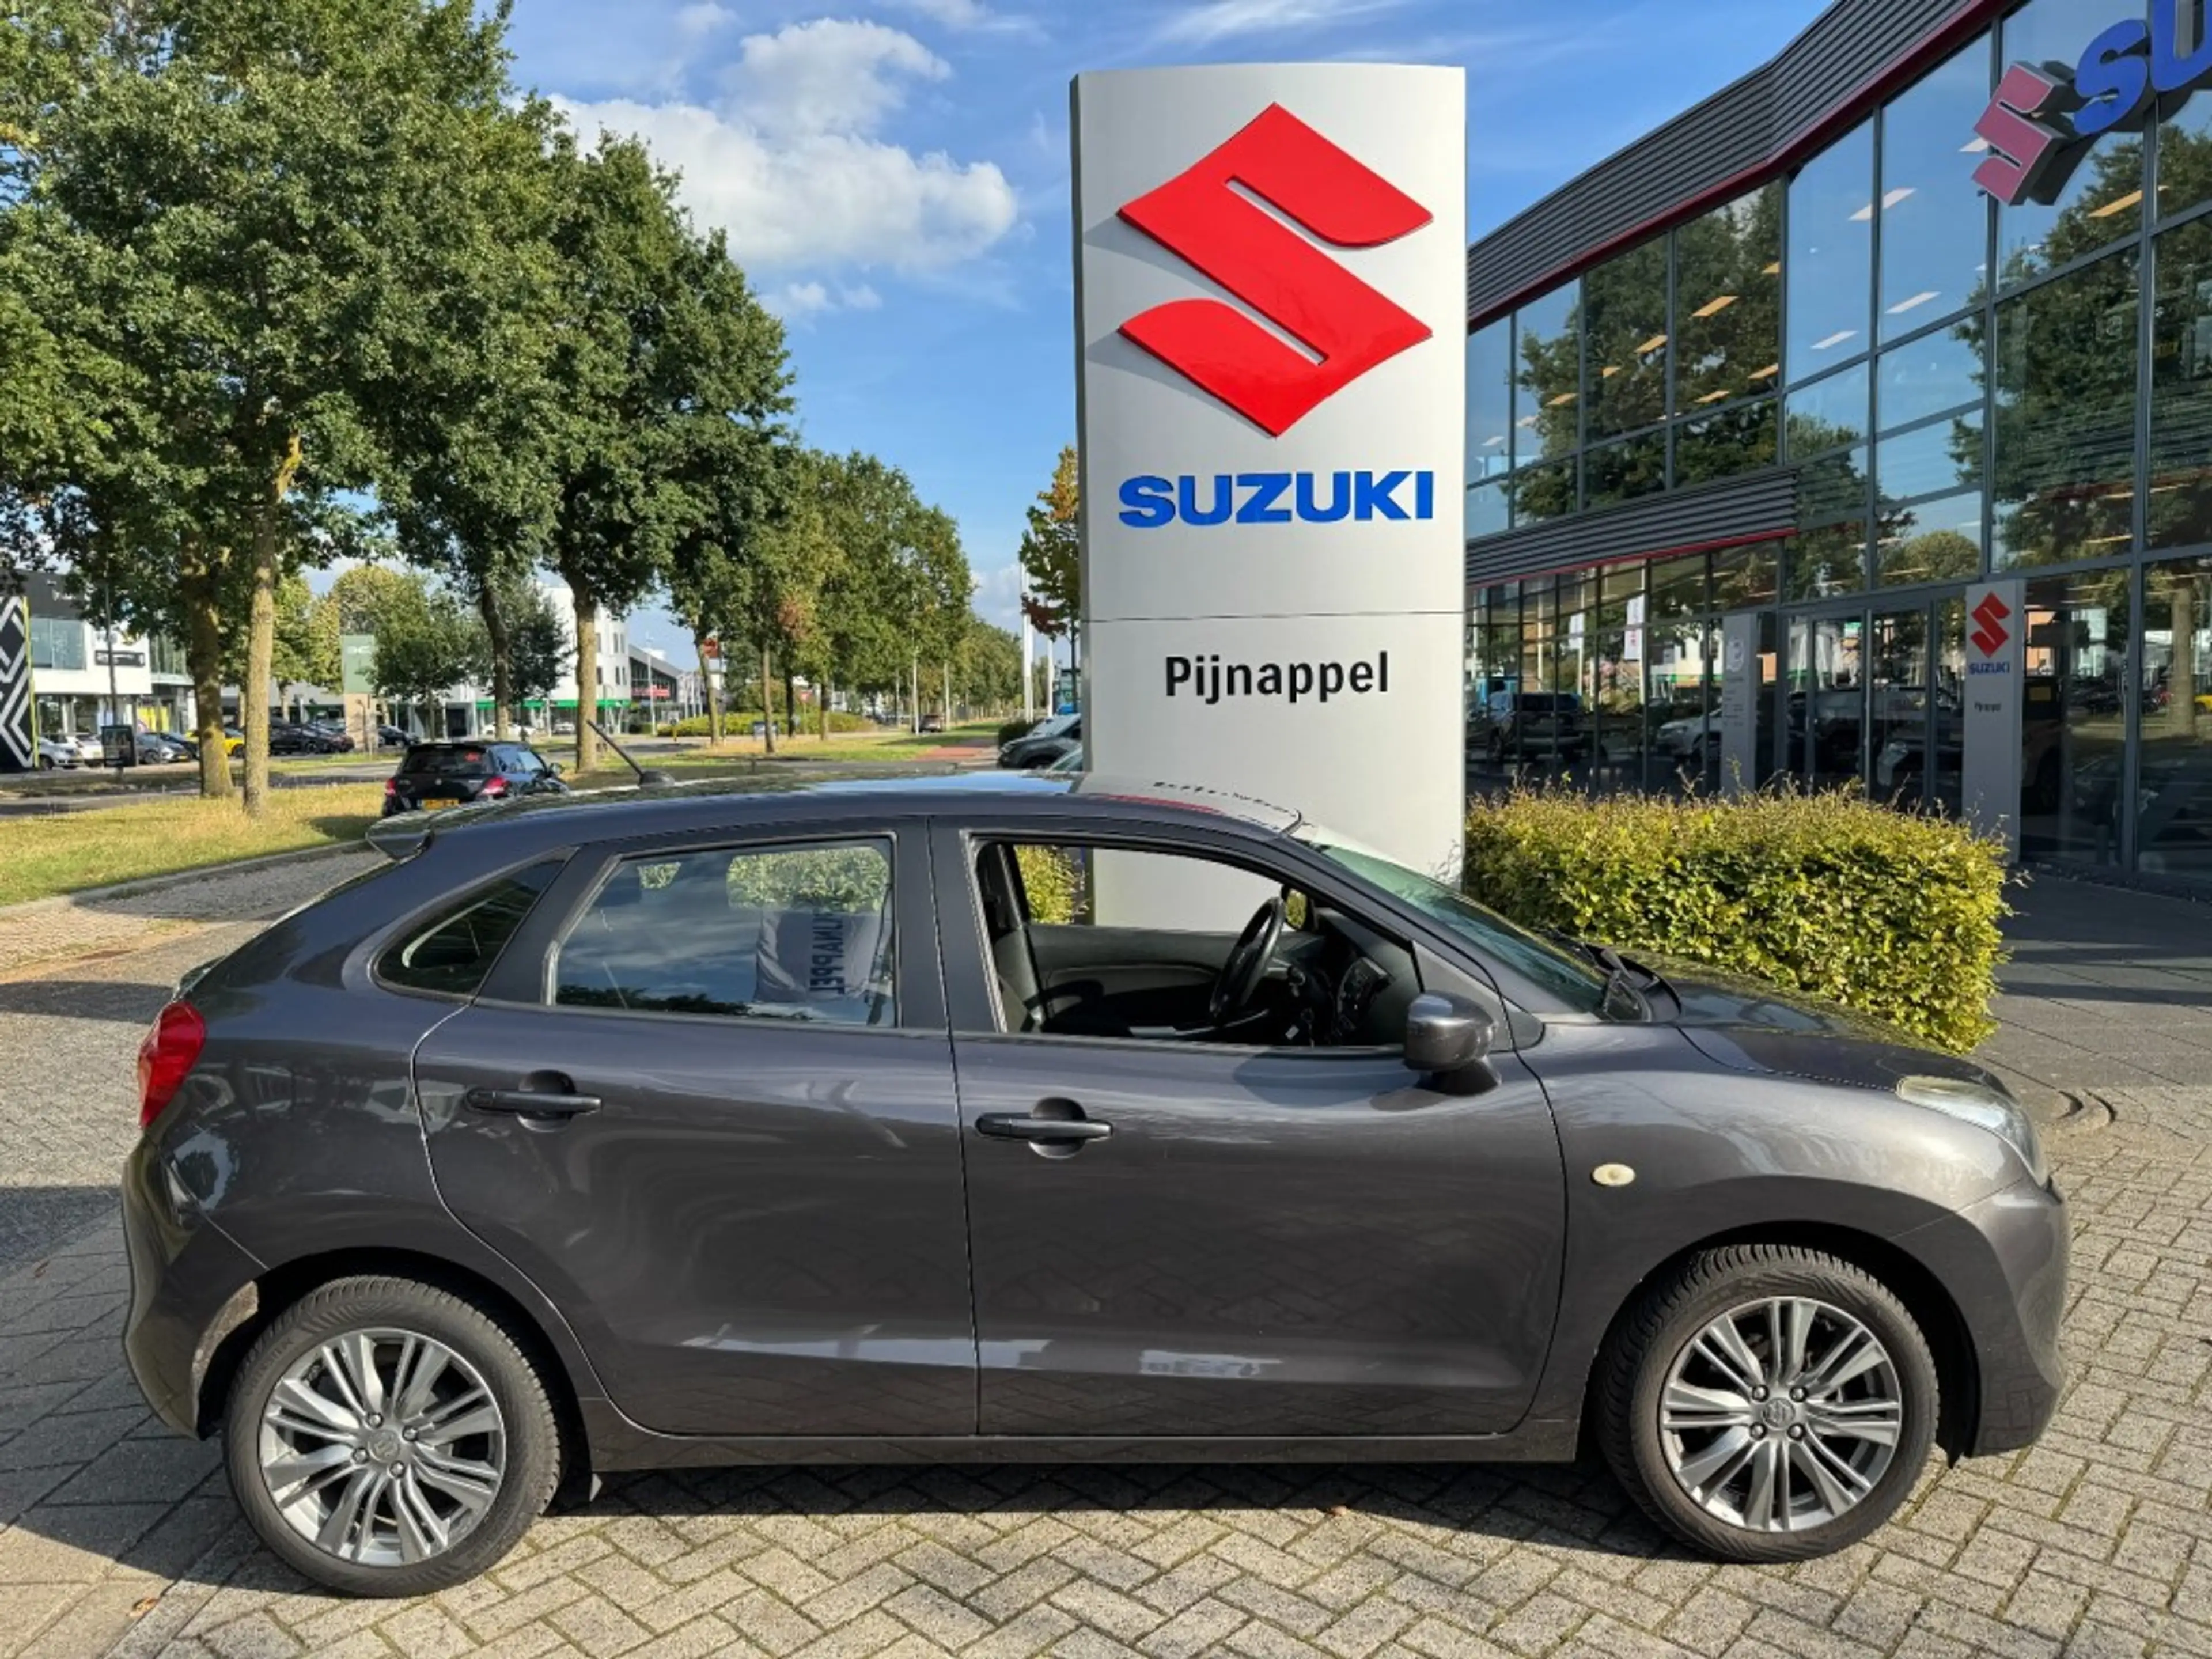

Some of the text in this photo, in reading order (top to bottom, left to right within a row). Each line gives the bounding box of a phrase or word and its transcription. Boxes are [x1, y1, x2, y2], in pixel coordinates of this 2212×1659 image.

[1119, 471, 1433, 528] SUZUKI
[1165, 651, 1388, 704] Pijnappel
[1969, 661, 2010, 675] SUZUKI
